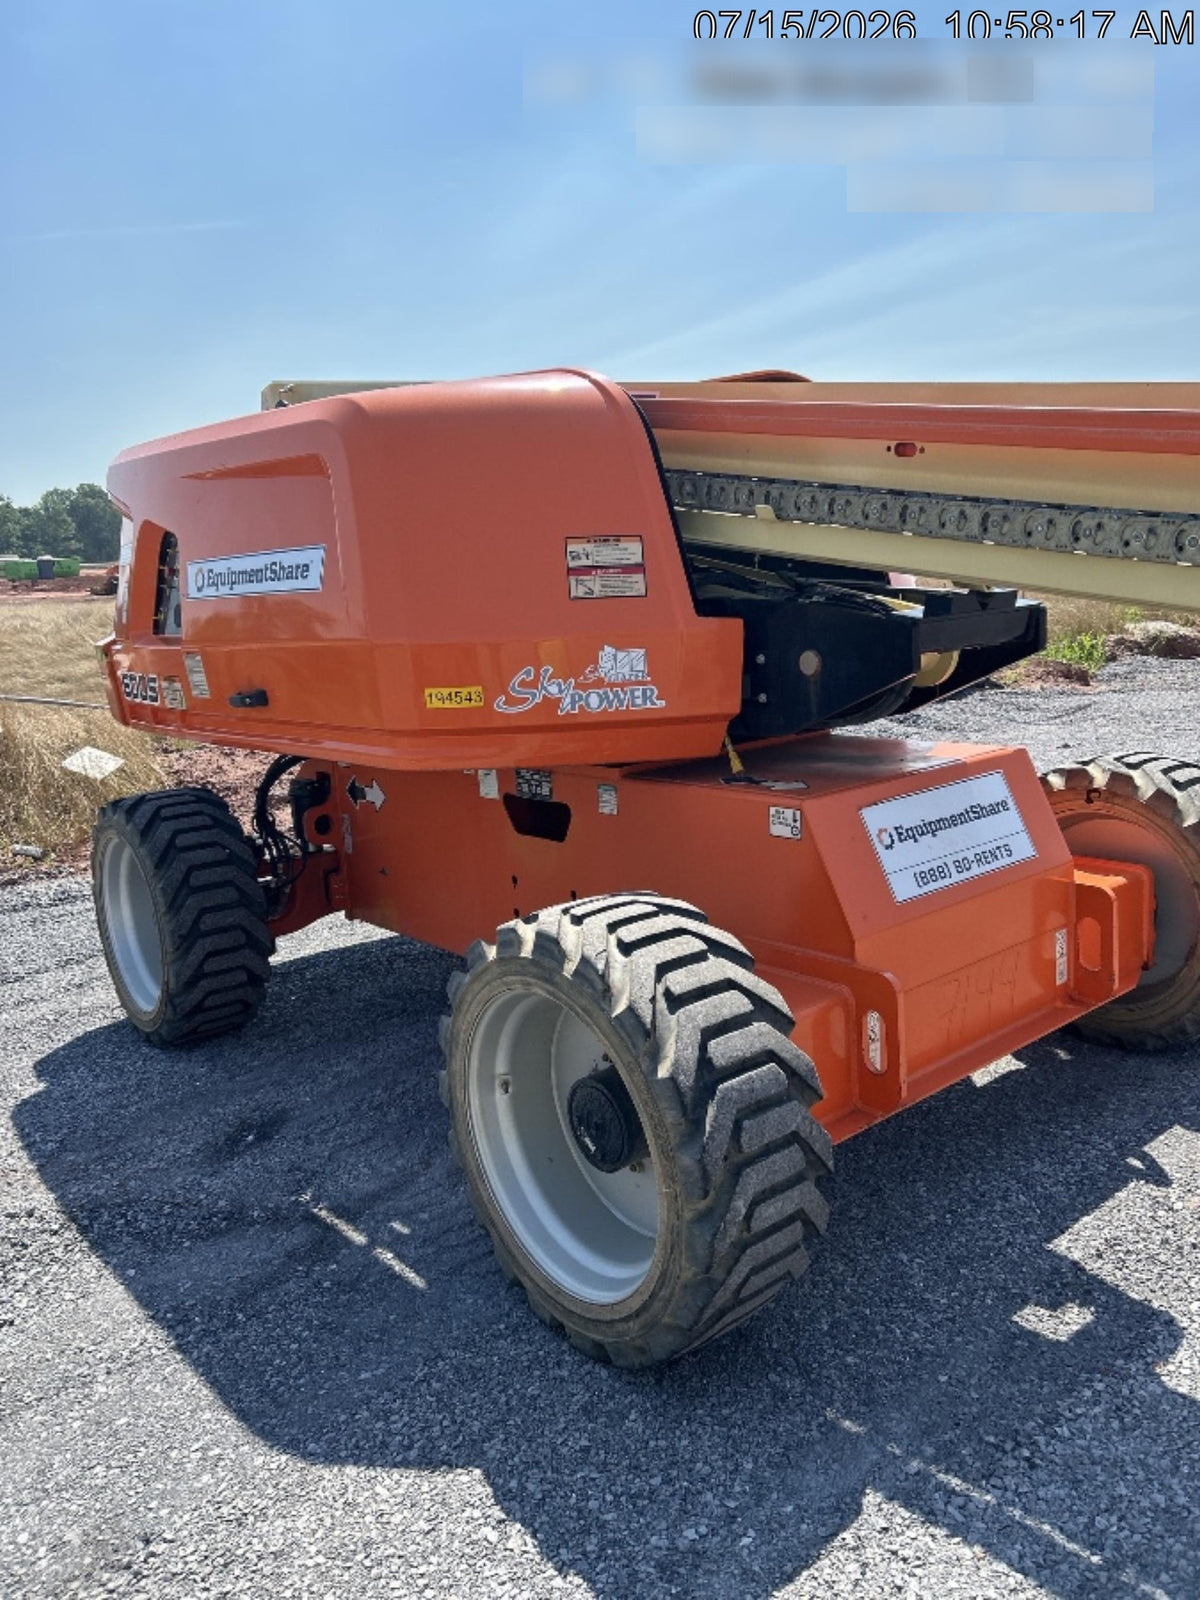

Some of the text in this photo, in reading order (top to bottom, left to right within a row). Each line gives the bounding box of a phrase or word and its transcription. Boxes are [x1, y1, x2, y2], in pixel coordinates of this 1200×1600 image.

[206, 560, 310, 592] EquipmentShare
[427, 688, 483, 706] 194543
[494, 665, 575, 715] Sky
[566, 685, 658, 714] POWER
[893, 798, 1011, 844] EquipmentShare
[913, 861, 953, 888] (888)
